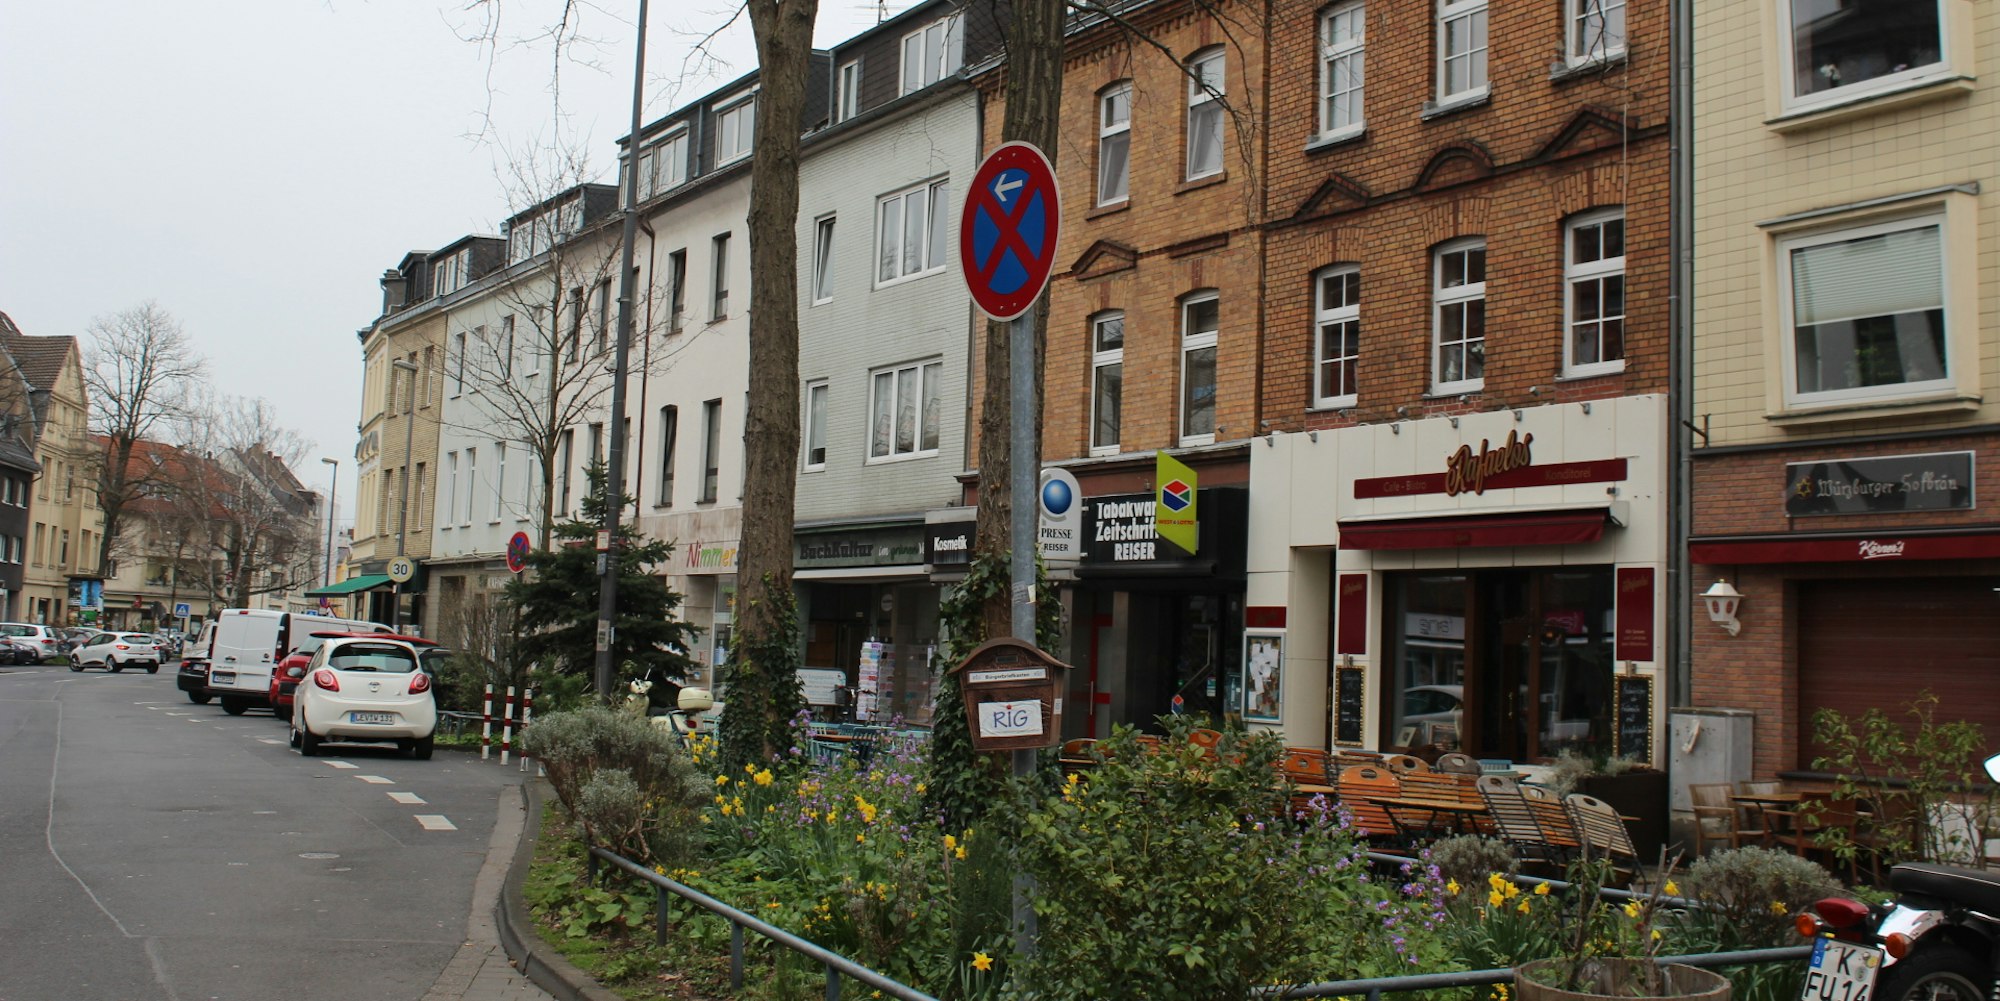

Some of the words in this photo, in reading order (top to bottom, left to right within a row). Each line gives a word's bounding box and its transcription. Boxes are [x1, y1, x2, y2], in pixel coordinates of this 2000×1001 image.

[1544, 467, 1592, 482] Konditorei
[1406, 479, 1427, 491] Bistro
[1817, 478, 1894, 500] Würzburger
[1041, 527, 1073, 540] PRESSE
[800, 541, 874, 559] BuchKultur
[933, 535, 968, 551] Kosmetik
[1044, 543, 1069, 552] REISER
[1113, 541, 1156, 561] REISER
[393, 563, 408, 575] 30
[985, 672, 1030, 680] Bürgerbriefkasten
[993, 709, 1028, 728] RIG
[1837, 946, 1857, 975] K
